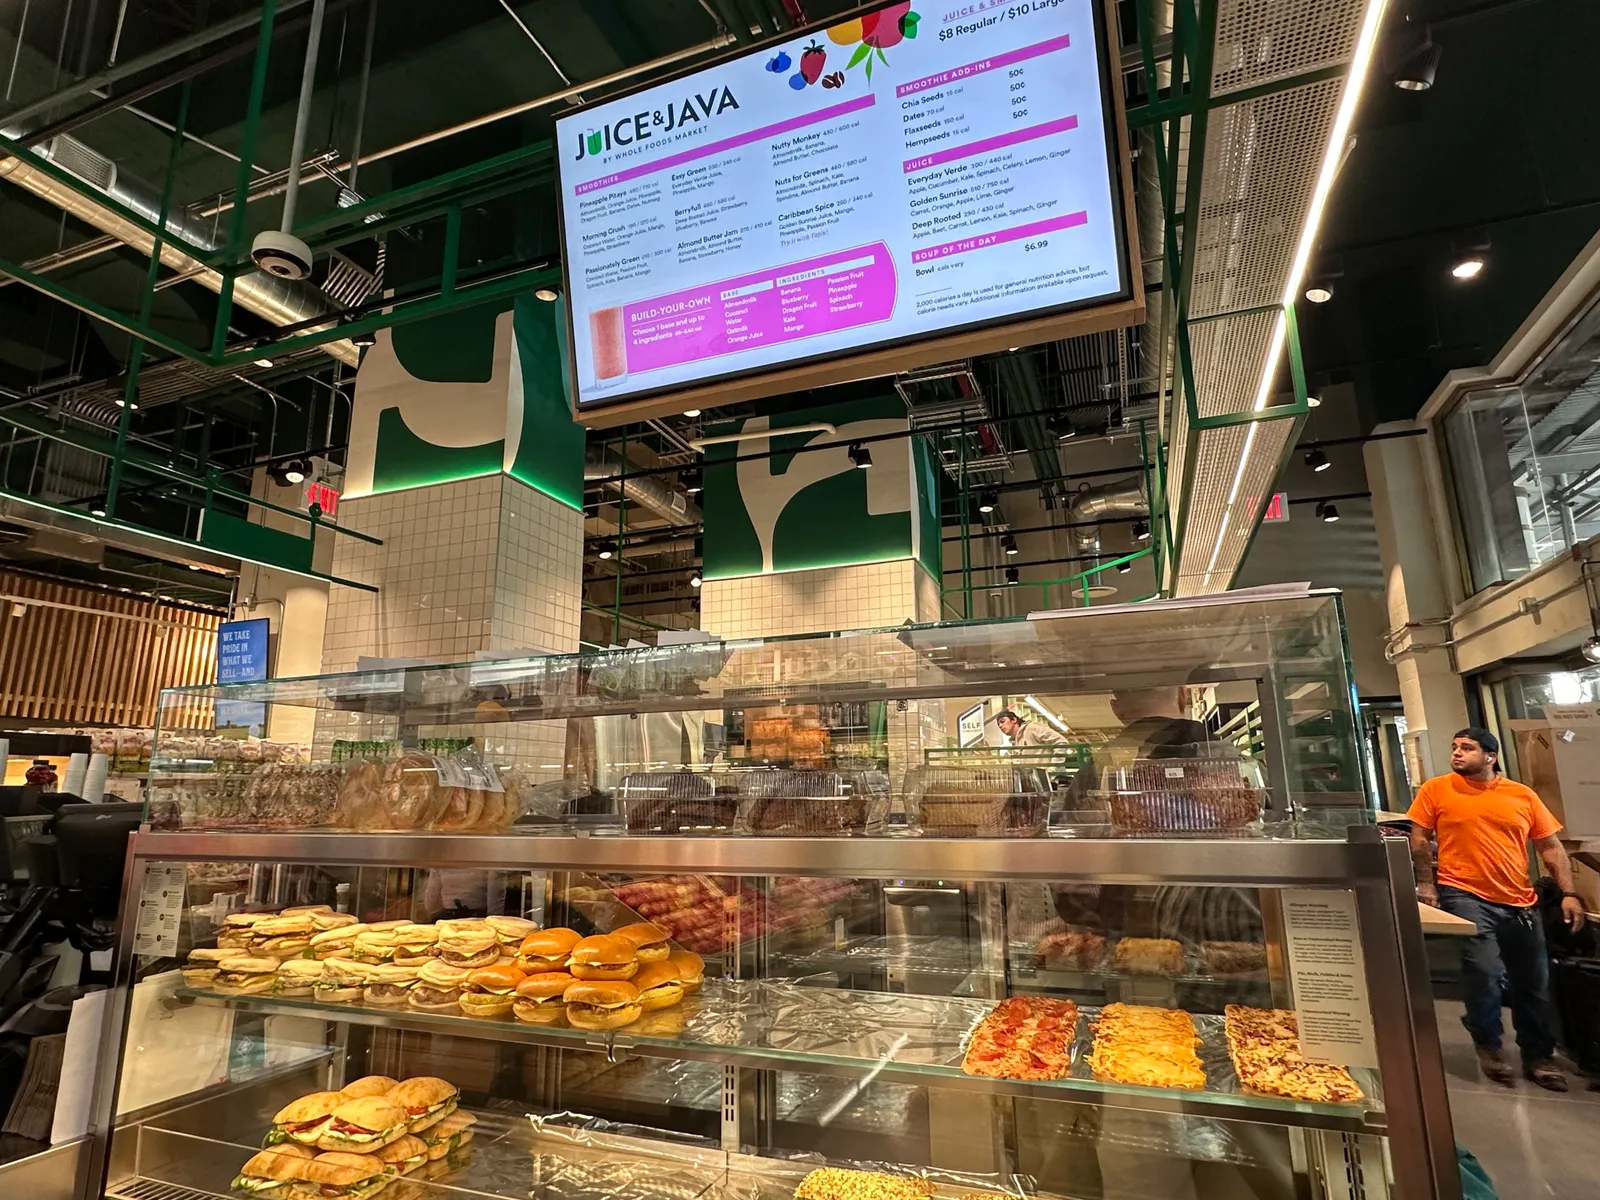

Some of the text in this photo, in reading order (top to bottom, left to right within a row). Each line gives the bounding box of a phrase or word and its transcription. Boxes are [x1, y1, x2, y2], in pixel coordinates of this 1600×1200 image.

[938, 28, 953, 41] $8
[955, 16, 997, 35] Regular
[1008, 3, 1029, 19] $10
[900, 60, 990, 93] SMOOTHIE ADD-INS
[901, 99, 919, 109] Chia
[920, 91, 944, 104] Seeds
[1008, 67, 1023, 78] 50¢
[902, 111, 924, 122] Dates
[1009, 81, 1025, 91] 50¢
[904, 119, 941, 136] Flaxseeds
[1011, 95, 1026, 105] 50¢
[905, 130, 950, 148] Hempseeds
[1012, 108, 1027, 119] 50¢
[603, 124, 707, 164] BY WHOLE FOODS MARKET
[771, 132, 820, 151] Nutty Monkey
[906, 156, 932, 170] JUICE
[671, 166, 706, 181] Easy Green
[774, 177, 791, 186] Nuts
[803, 167, 828, 178] Greens
[907, 164, 967, 185] Everyday Verde
[909, 188, 968, 207] Golden Sunrise
[777, 202, 834, 221] Caribbean Spice
[911, 211, 961, 230] Deep Rooted
[677, 229, 738, 249] Almond Butter Jam
[915, 235, 996, 260] SOUP OF THE DAY
[915, 265, 934, 276] Bowl
[1024, 239, 1048, 252] $6.99
[779, 269, 824, 284] INGREDIENTS
[631, 295, 710, 322] BUILD-YOUR-OWN
[632, 326, 655, 336] Choose
[660, 322, 674, 330] base
[675, 317, 687, 326] and
[688, 316, 696, 324] up
[638, 331, 672, 344] ingredients
[223, 630, 250, 641] WE TAKE
[222, 643, 248, 654] PRIDE IN
[222, 655, 252, 666] WHAT WE
